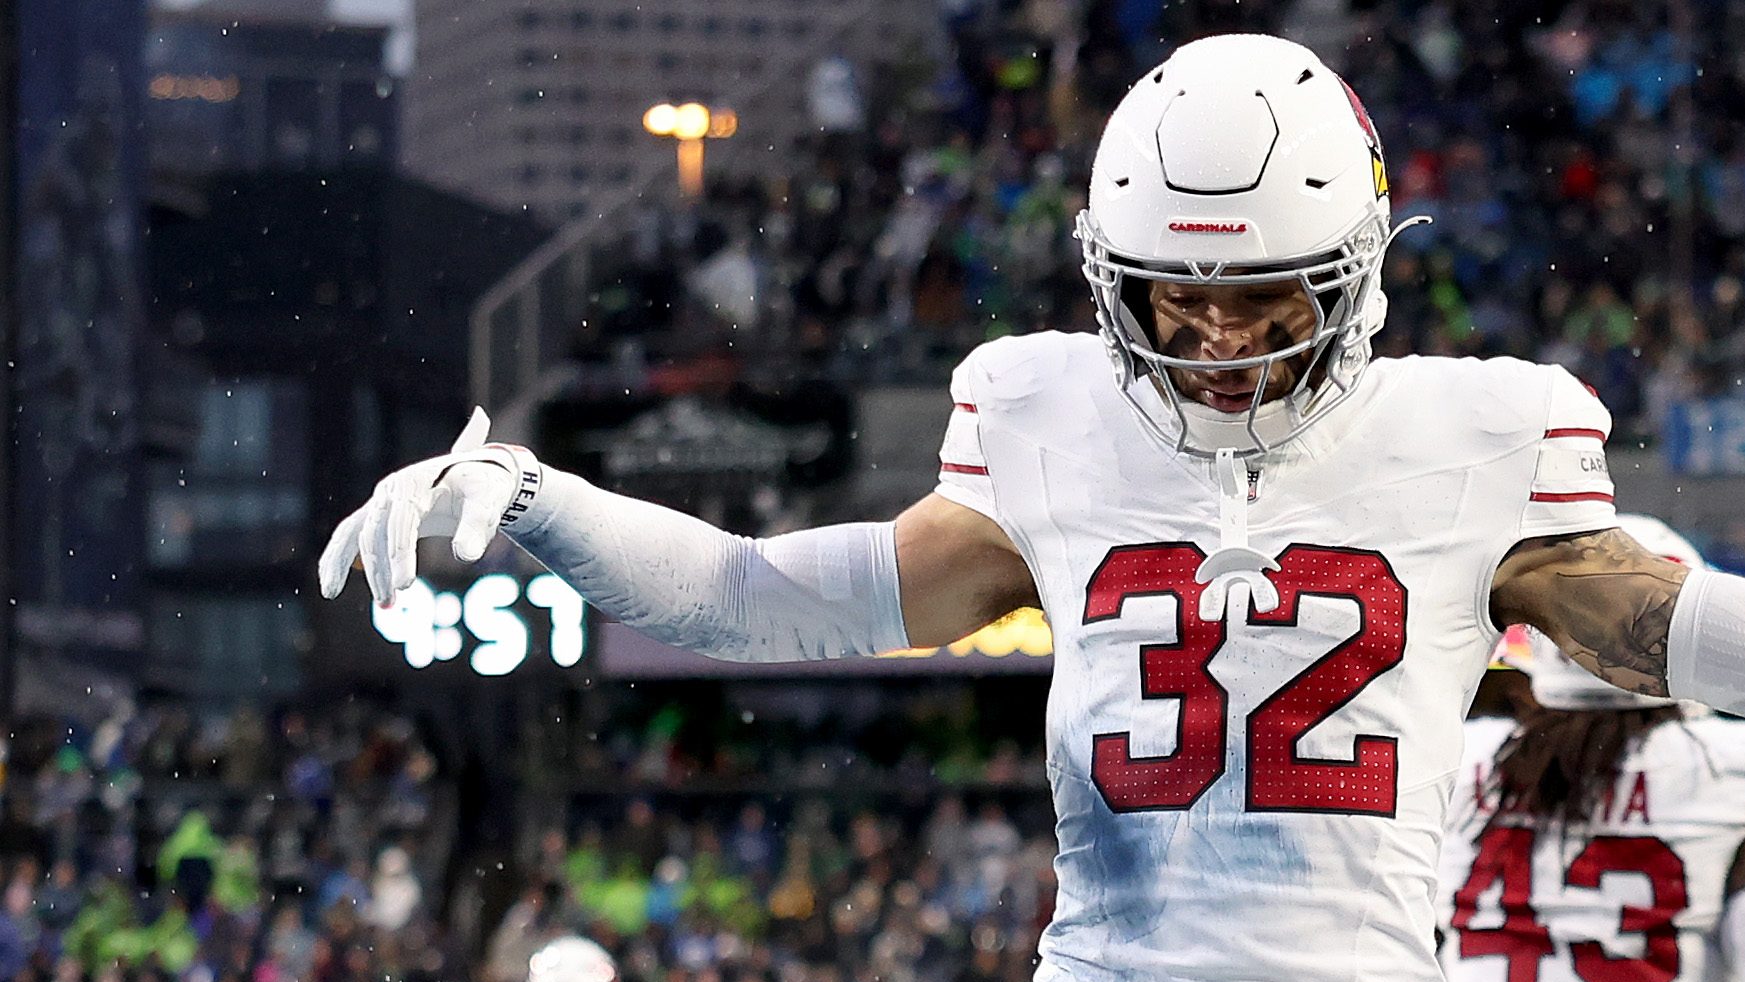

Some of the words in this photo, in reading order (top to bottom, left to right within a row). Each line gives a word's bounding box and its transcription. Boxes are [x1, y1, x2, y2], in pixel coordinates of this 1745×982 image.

[1168, 222, 1247, 233] CARDINALS
[1580, 457, 1608, 473] CAR
[1082, 541, 1408, 818] 32
